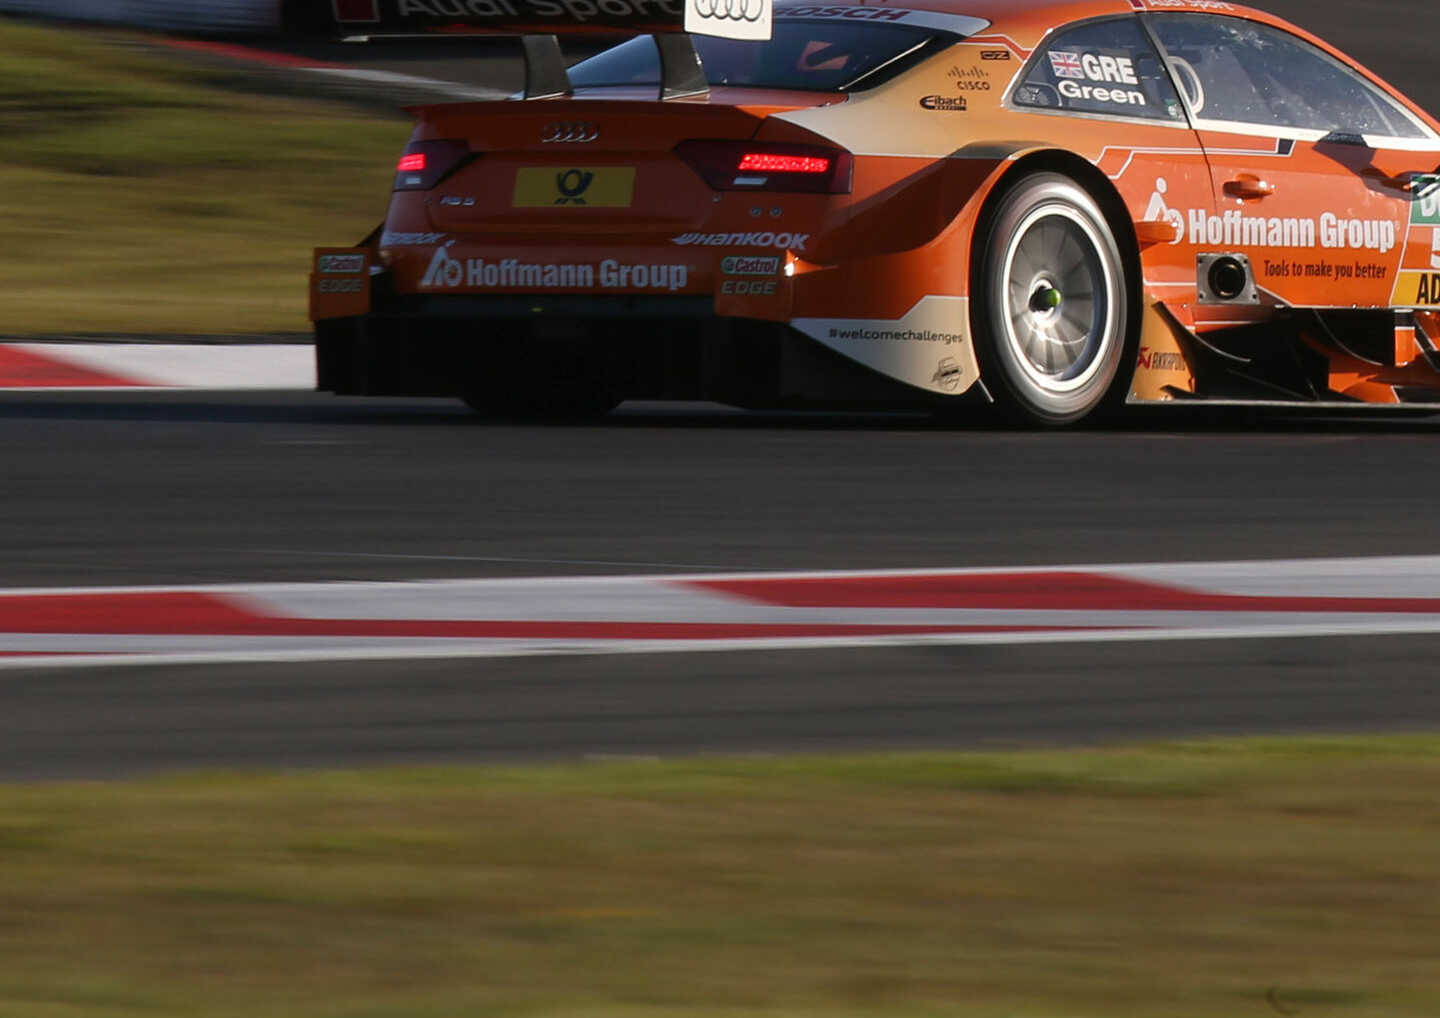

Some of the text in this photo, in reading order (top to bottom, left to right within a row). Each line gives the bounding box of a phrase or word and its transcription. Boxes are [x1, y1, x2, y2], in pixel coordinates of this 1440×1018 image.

[1082, 53, 1139, 85] GRE
[919, 95, 967, 111] Eibach
[1058, 80, 1146, 106] Green
[1188, 209, 1396, 254] Hoffmann Group
[466, 259, 688, 291] Hoffmann Group
[735, 257, 777, 273] Castrol
[1264, 259, 1387, 281] Tools to make you better
[721, 281, 777, 295] EDGE
[829, 328, 963, 344] #welcomechallenges
